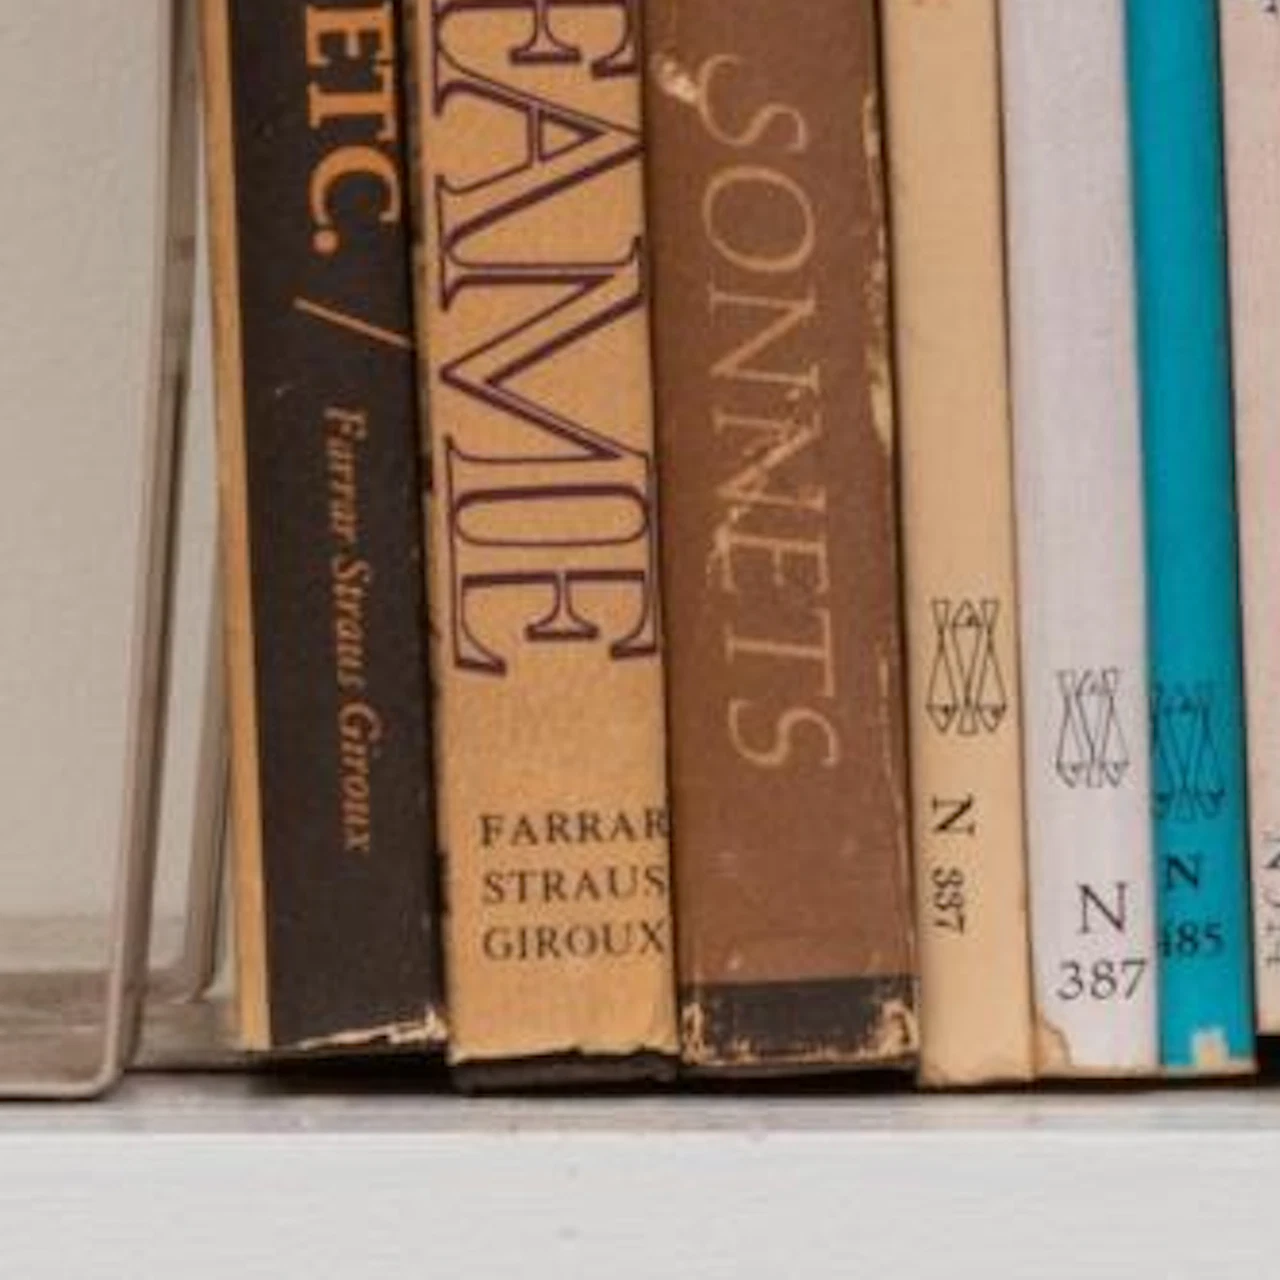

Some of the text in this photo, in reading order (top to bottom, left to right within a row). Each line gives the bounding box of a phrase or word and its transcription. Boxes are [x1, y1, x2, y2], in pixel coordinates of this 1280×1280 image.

[305, 0, 401, 255] ETC.
[700, 52, 839, 768] SONNETS
[323, 405, 381, 853] Farrar Straus Giroux
[479, 806, 671, 847] FARRAR
[932, 793, 977, 836] N
[481, 864, 667, 906] STRAUS
[1163, 853, 1200, 890] N
[1076, 881, 1128, 934] N
[481, 919, 668, 961] GIROUX
[1056, 959, 1148, 1001] 387
